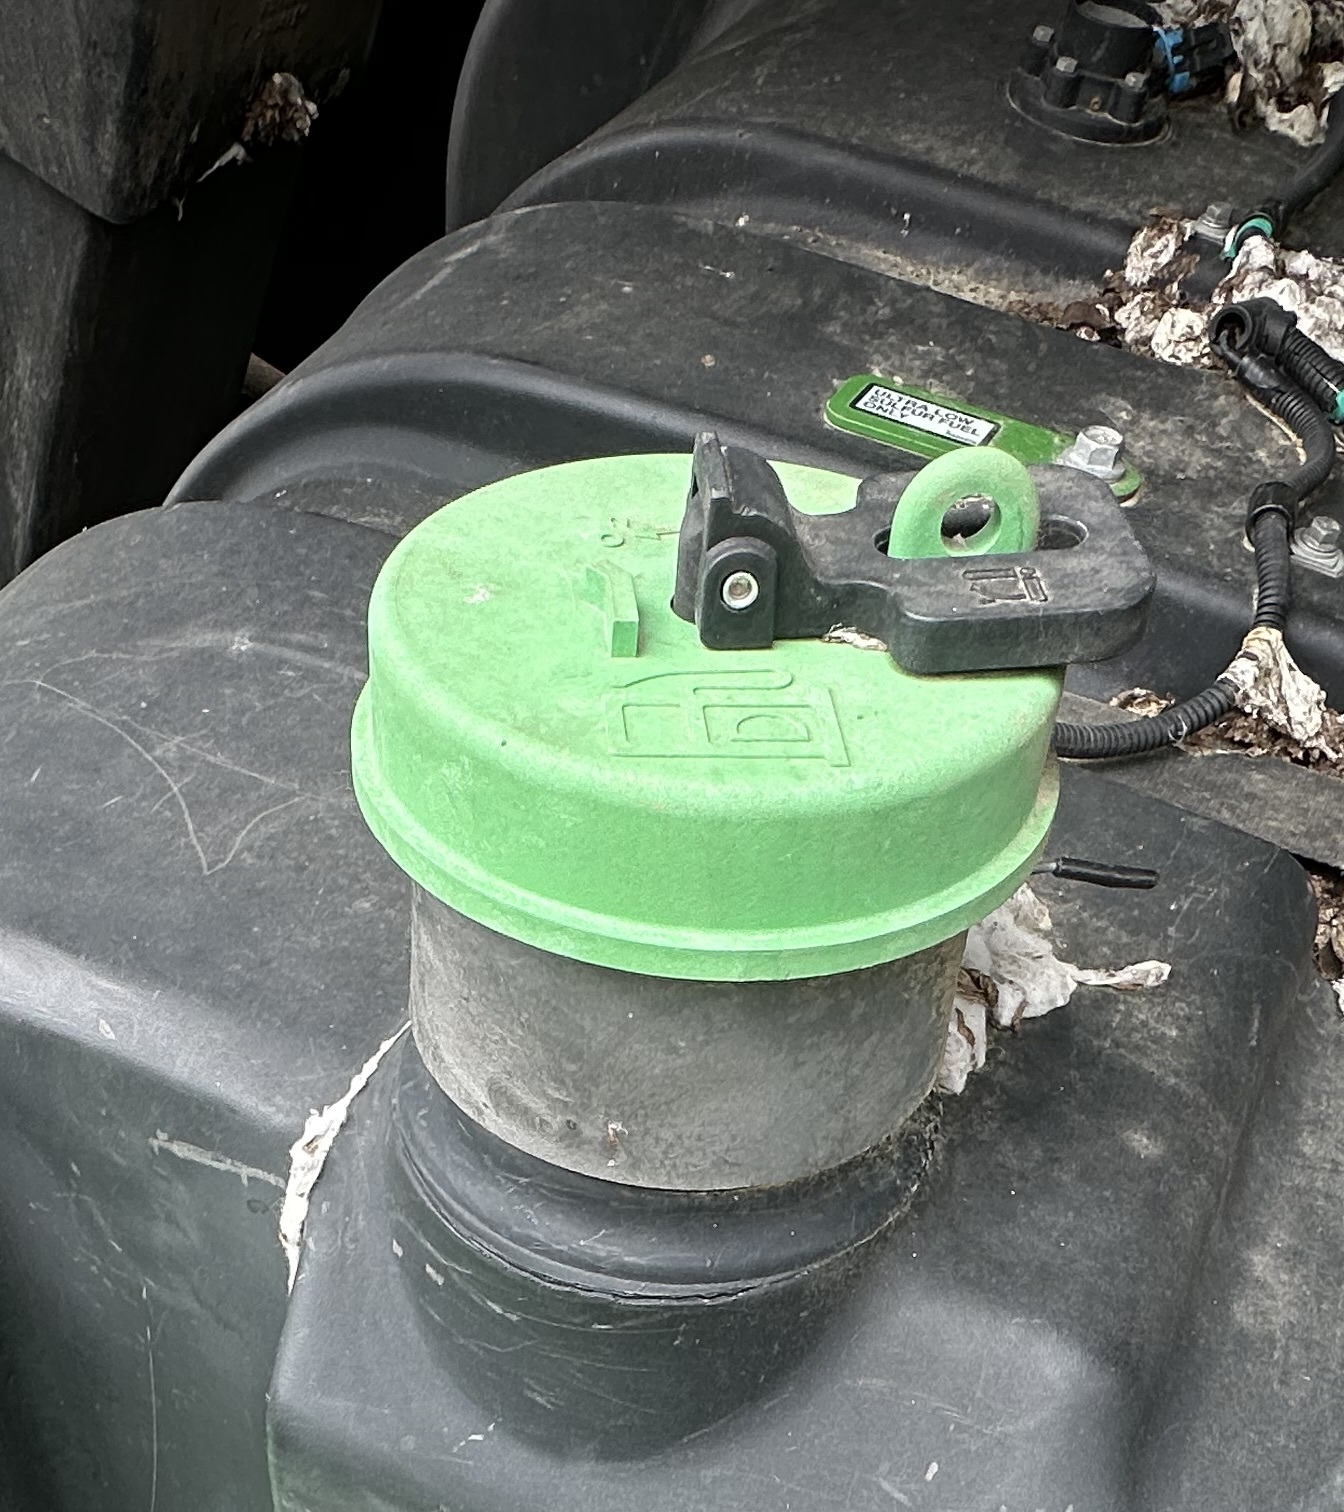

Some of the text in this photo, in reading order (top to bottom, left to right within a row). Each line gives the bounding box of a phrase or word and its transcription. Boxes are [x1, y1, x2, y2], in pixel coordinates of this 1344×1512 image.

[862, 400, 911, 420] ONLY
[869, 395, 980, 436] SULFUR FUEL
[874, 389, 975, 425] ULTRA LOW
